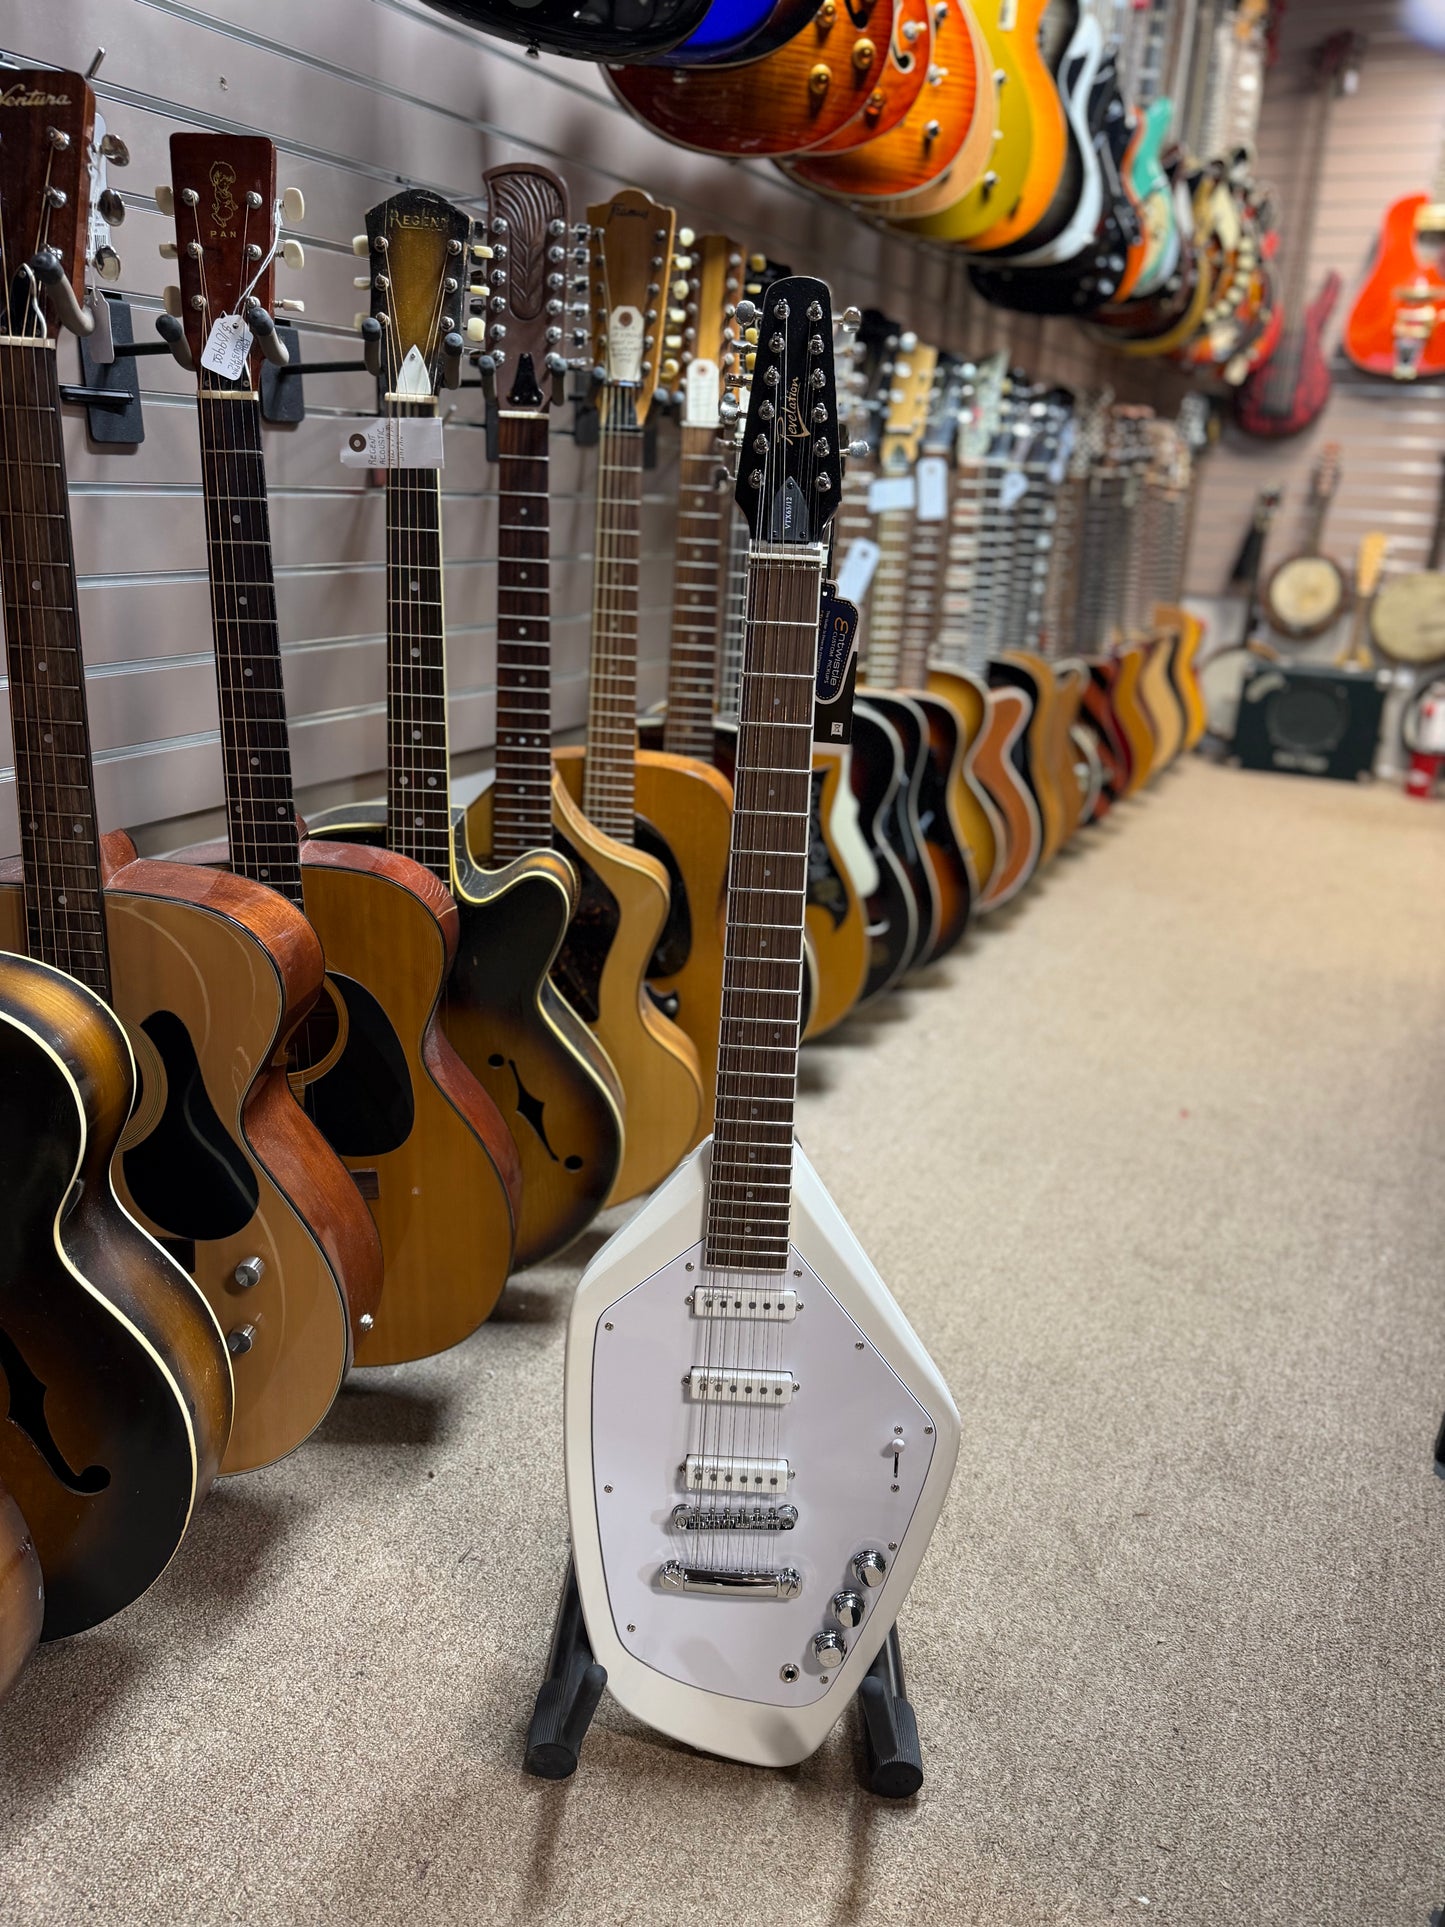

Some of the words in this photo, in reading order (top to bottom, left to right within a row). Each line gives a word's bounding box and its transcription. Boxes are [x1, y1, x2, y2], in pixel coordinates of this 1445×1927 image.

[210, 230, 237, 238] PAN
[776, 376, 811, 446] Revelation
[367, 433, 377, 465] REGENT
[377, 427, 386, 465] ACOUSTIC
[785, 496, 793, 529] VTX63/12
[828, 631, 838, 657] CUSTOM
[829, 616, 849, 686] Entwistle
[823, 659, 833, 684] PICKUPS
